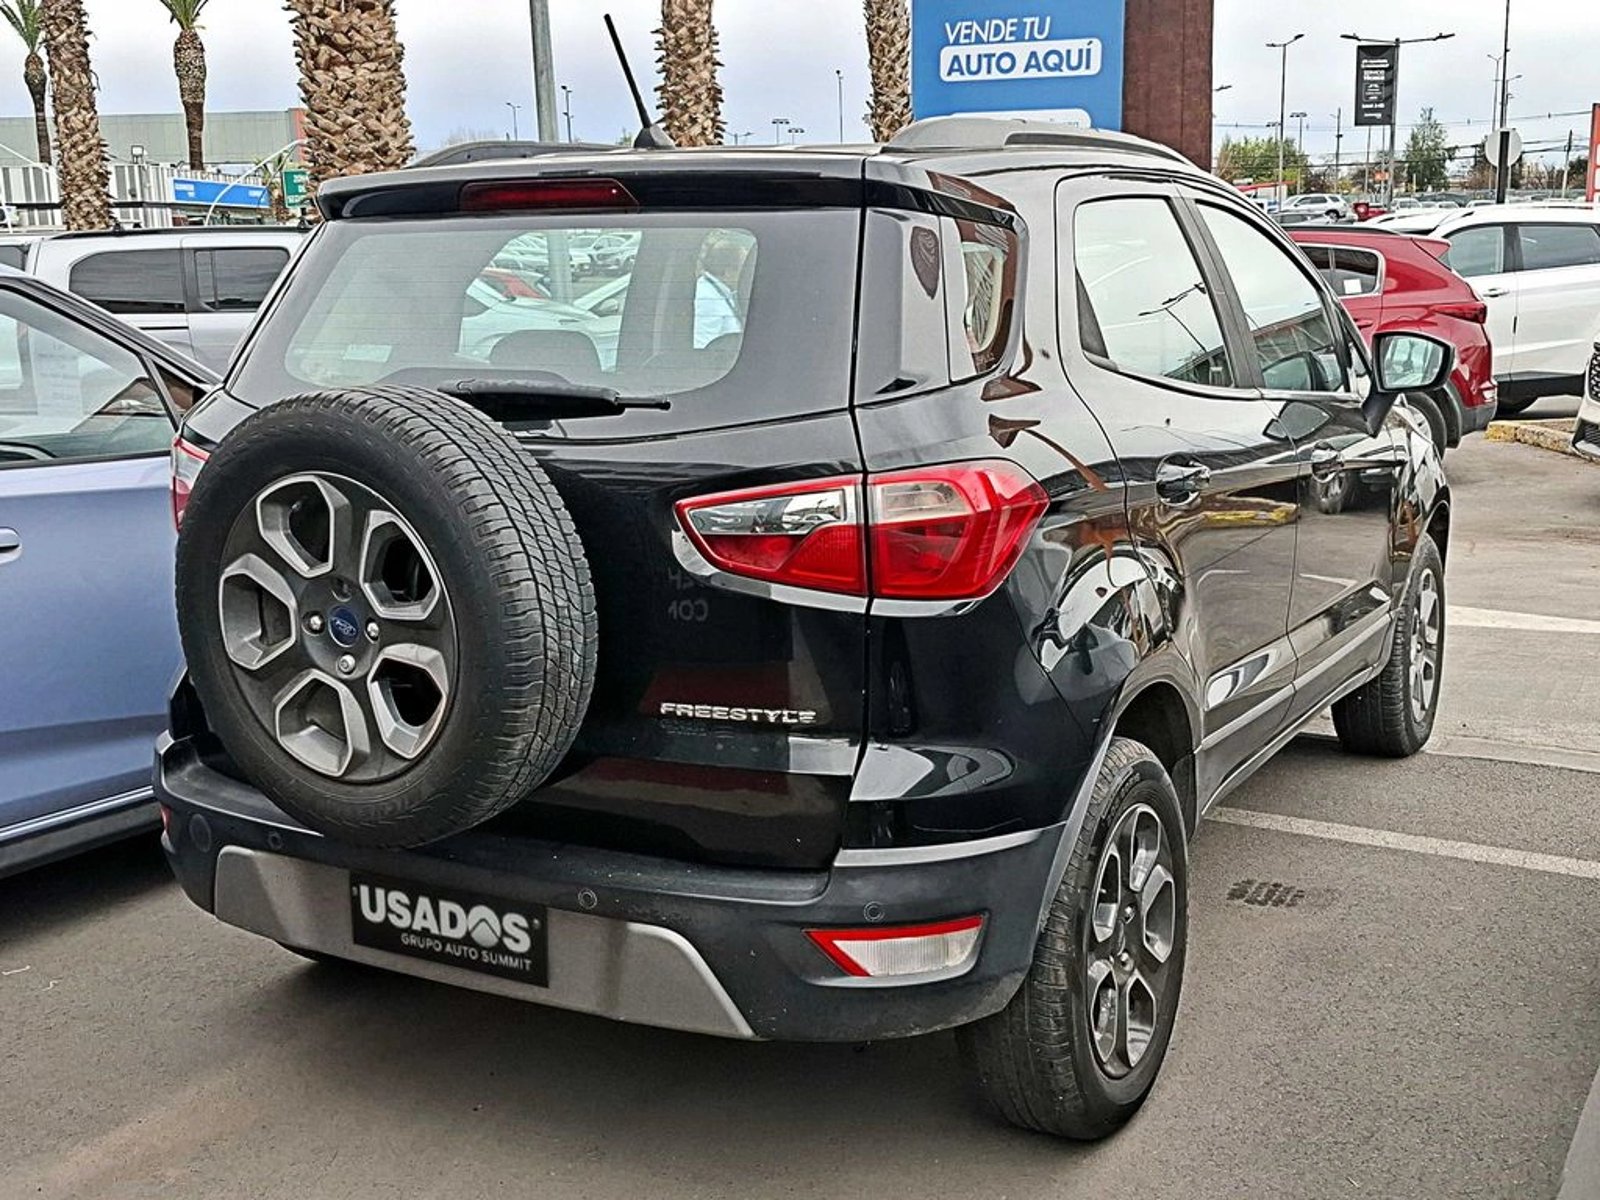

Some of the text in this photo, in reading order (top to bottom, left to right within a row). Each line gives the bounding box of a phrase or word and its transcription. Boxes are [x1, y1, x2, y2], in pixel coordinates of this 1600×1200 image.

[945, 15, 1051, 44] VENDE TU
[946, 40, 1094, 77] AUTO AQUÍ
[659, 702, 817, 724] FREESTYLE
[359, 884, 532, 954] USADOS
[401, 932, 532, 971] GRUPO AUTO SUMMIT
